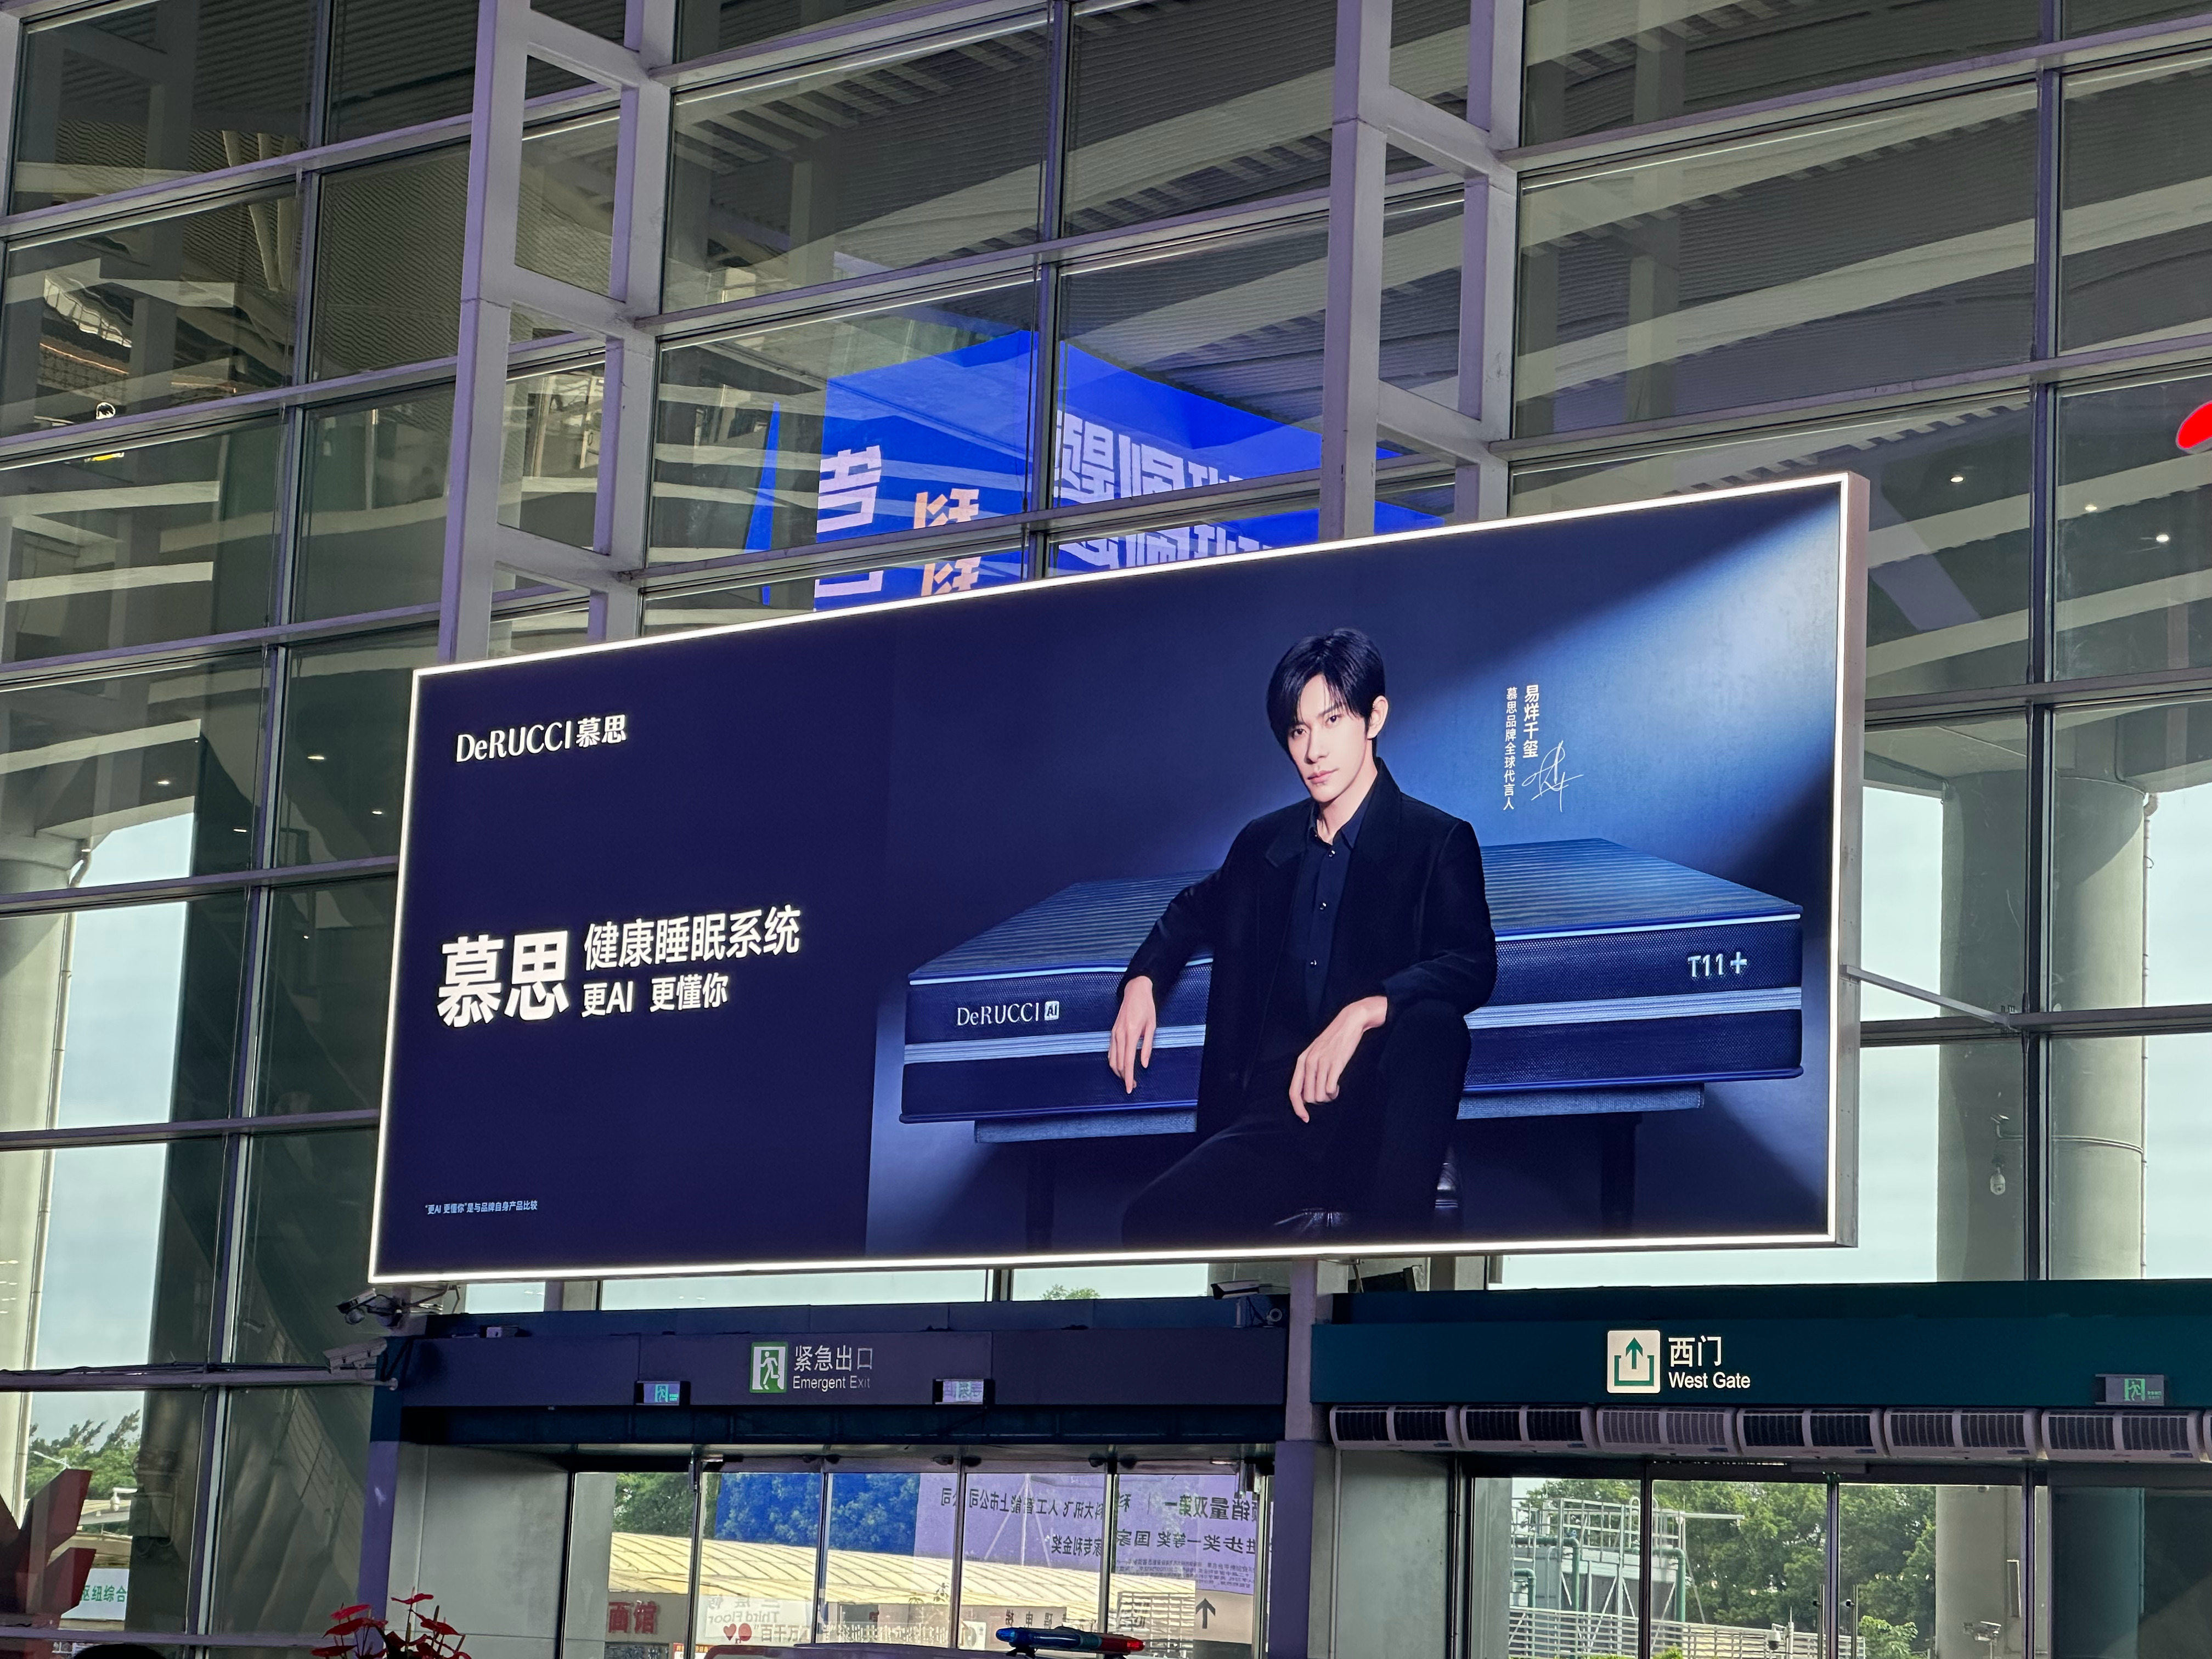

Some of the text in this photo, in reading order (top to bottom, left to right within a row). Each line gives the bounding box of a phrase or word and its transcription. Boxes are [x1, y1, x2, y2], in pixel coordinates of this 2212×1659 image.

[456, 714, 627, 762] DeRUCCI 慕思
[1523, 685, 1539, 758] 易烊千玺
[1503, 687, 1517, 811] 慕思品牌全球代言人
[584, 905, 801, 971] 健康睡眠系统
[437, 930, 569, 1028] 慕思
[1688, 951, 1748, 978] T11+
[582, 972, 729, 1017] 更AI 更懂你
[957, 1002, 1040, 1026] DeRUCCI
[794, 1345, 873, 1372] 紧急出口
[1668, 1336, 1722, 1367] 西门
[792, 1375, 870, 1392] Emergent Exit
[1668, 1372, 1751, 1389] West Gate
